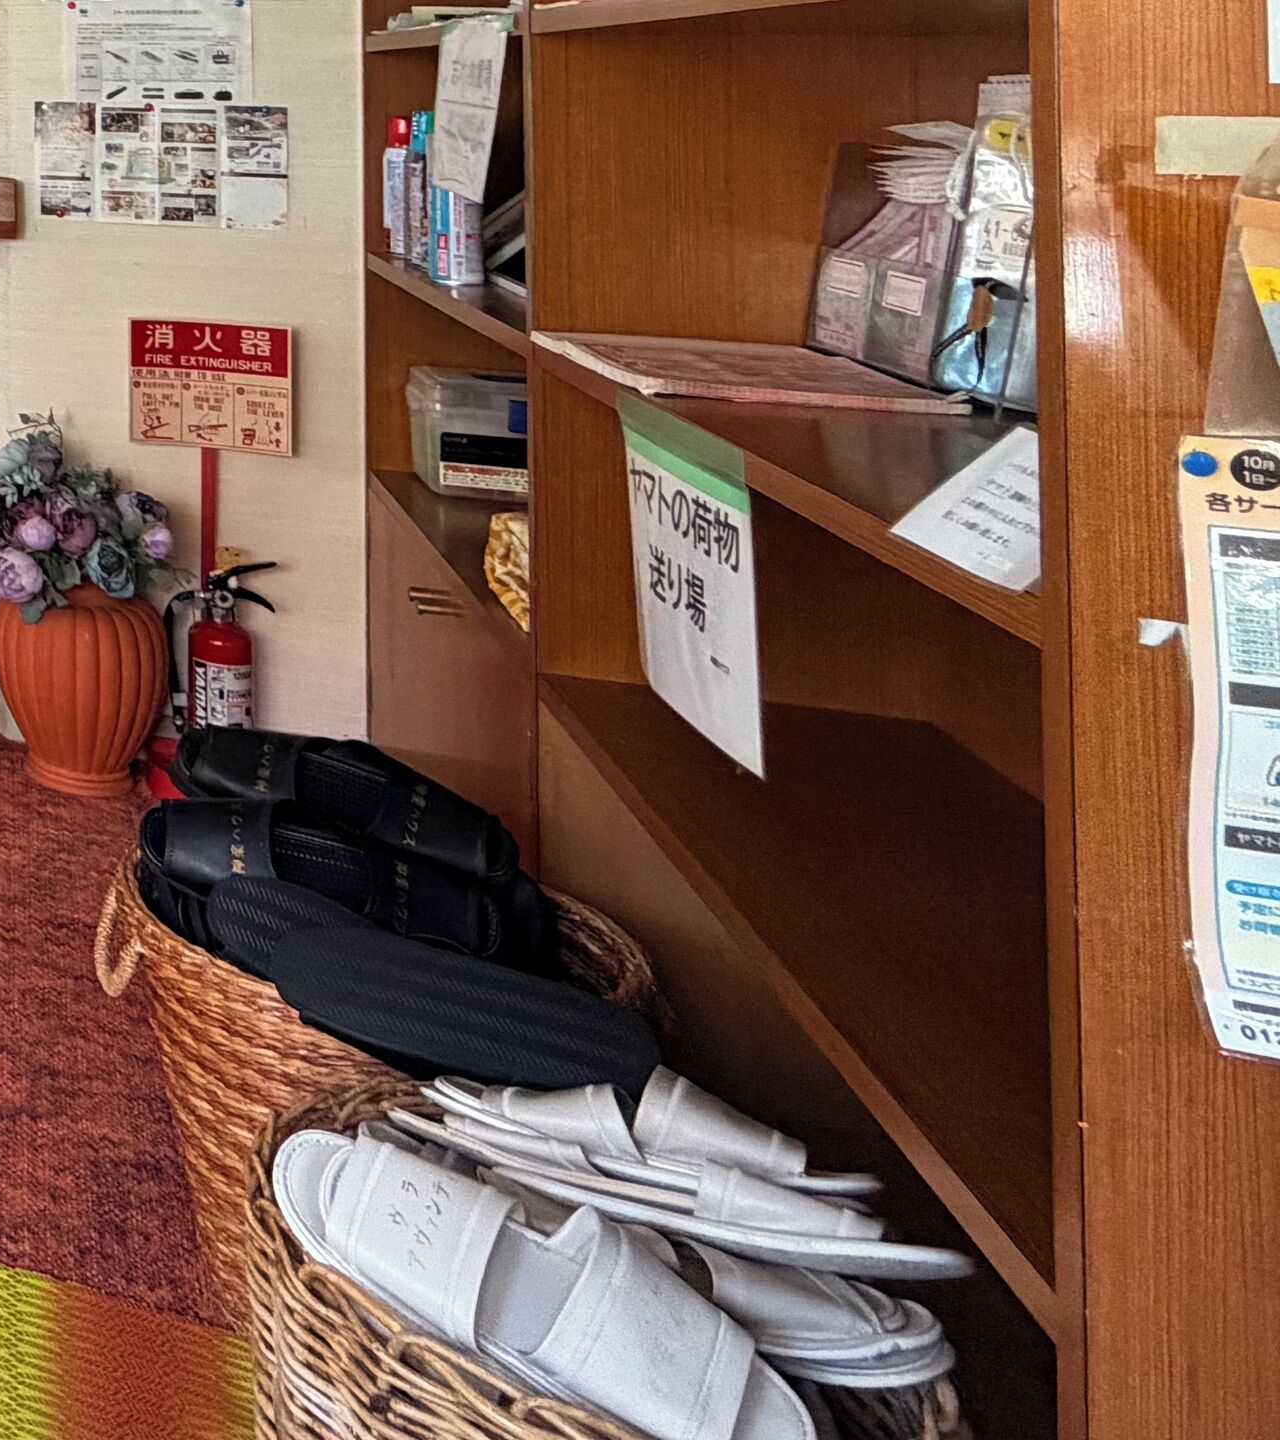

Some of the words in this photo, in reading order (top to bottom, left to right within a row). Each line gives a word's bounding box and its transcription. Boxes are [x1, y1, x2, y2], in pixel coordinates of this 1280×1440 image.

[144, 324, 272, 357] 消火器
[144, 353, 174, 366] FIRE
[180, 355, 273, 372] EXTINGUISHER
[1241, 454, 1276, 472] 10月
[629, 458, 742, 574] ヤマトの荷物
[648, 543, 707, 632] 送り場
